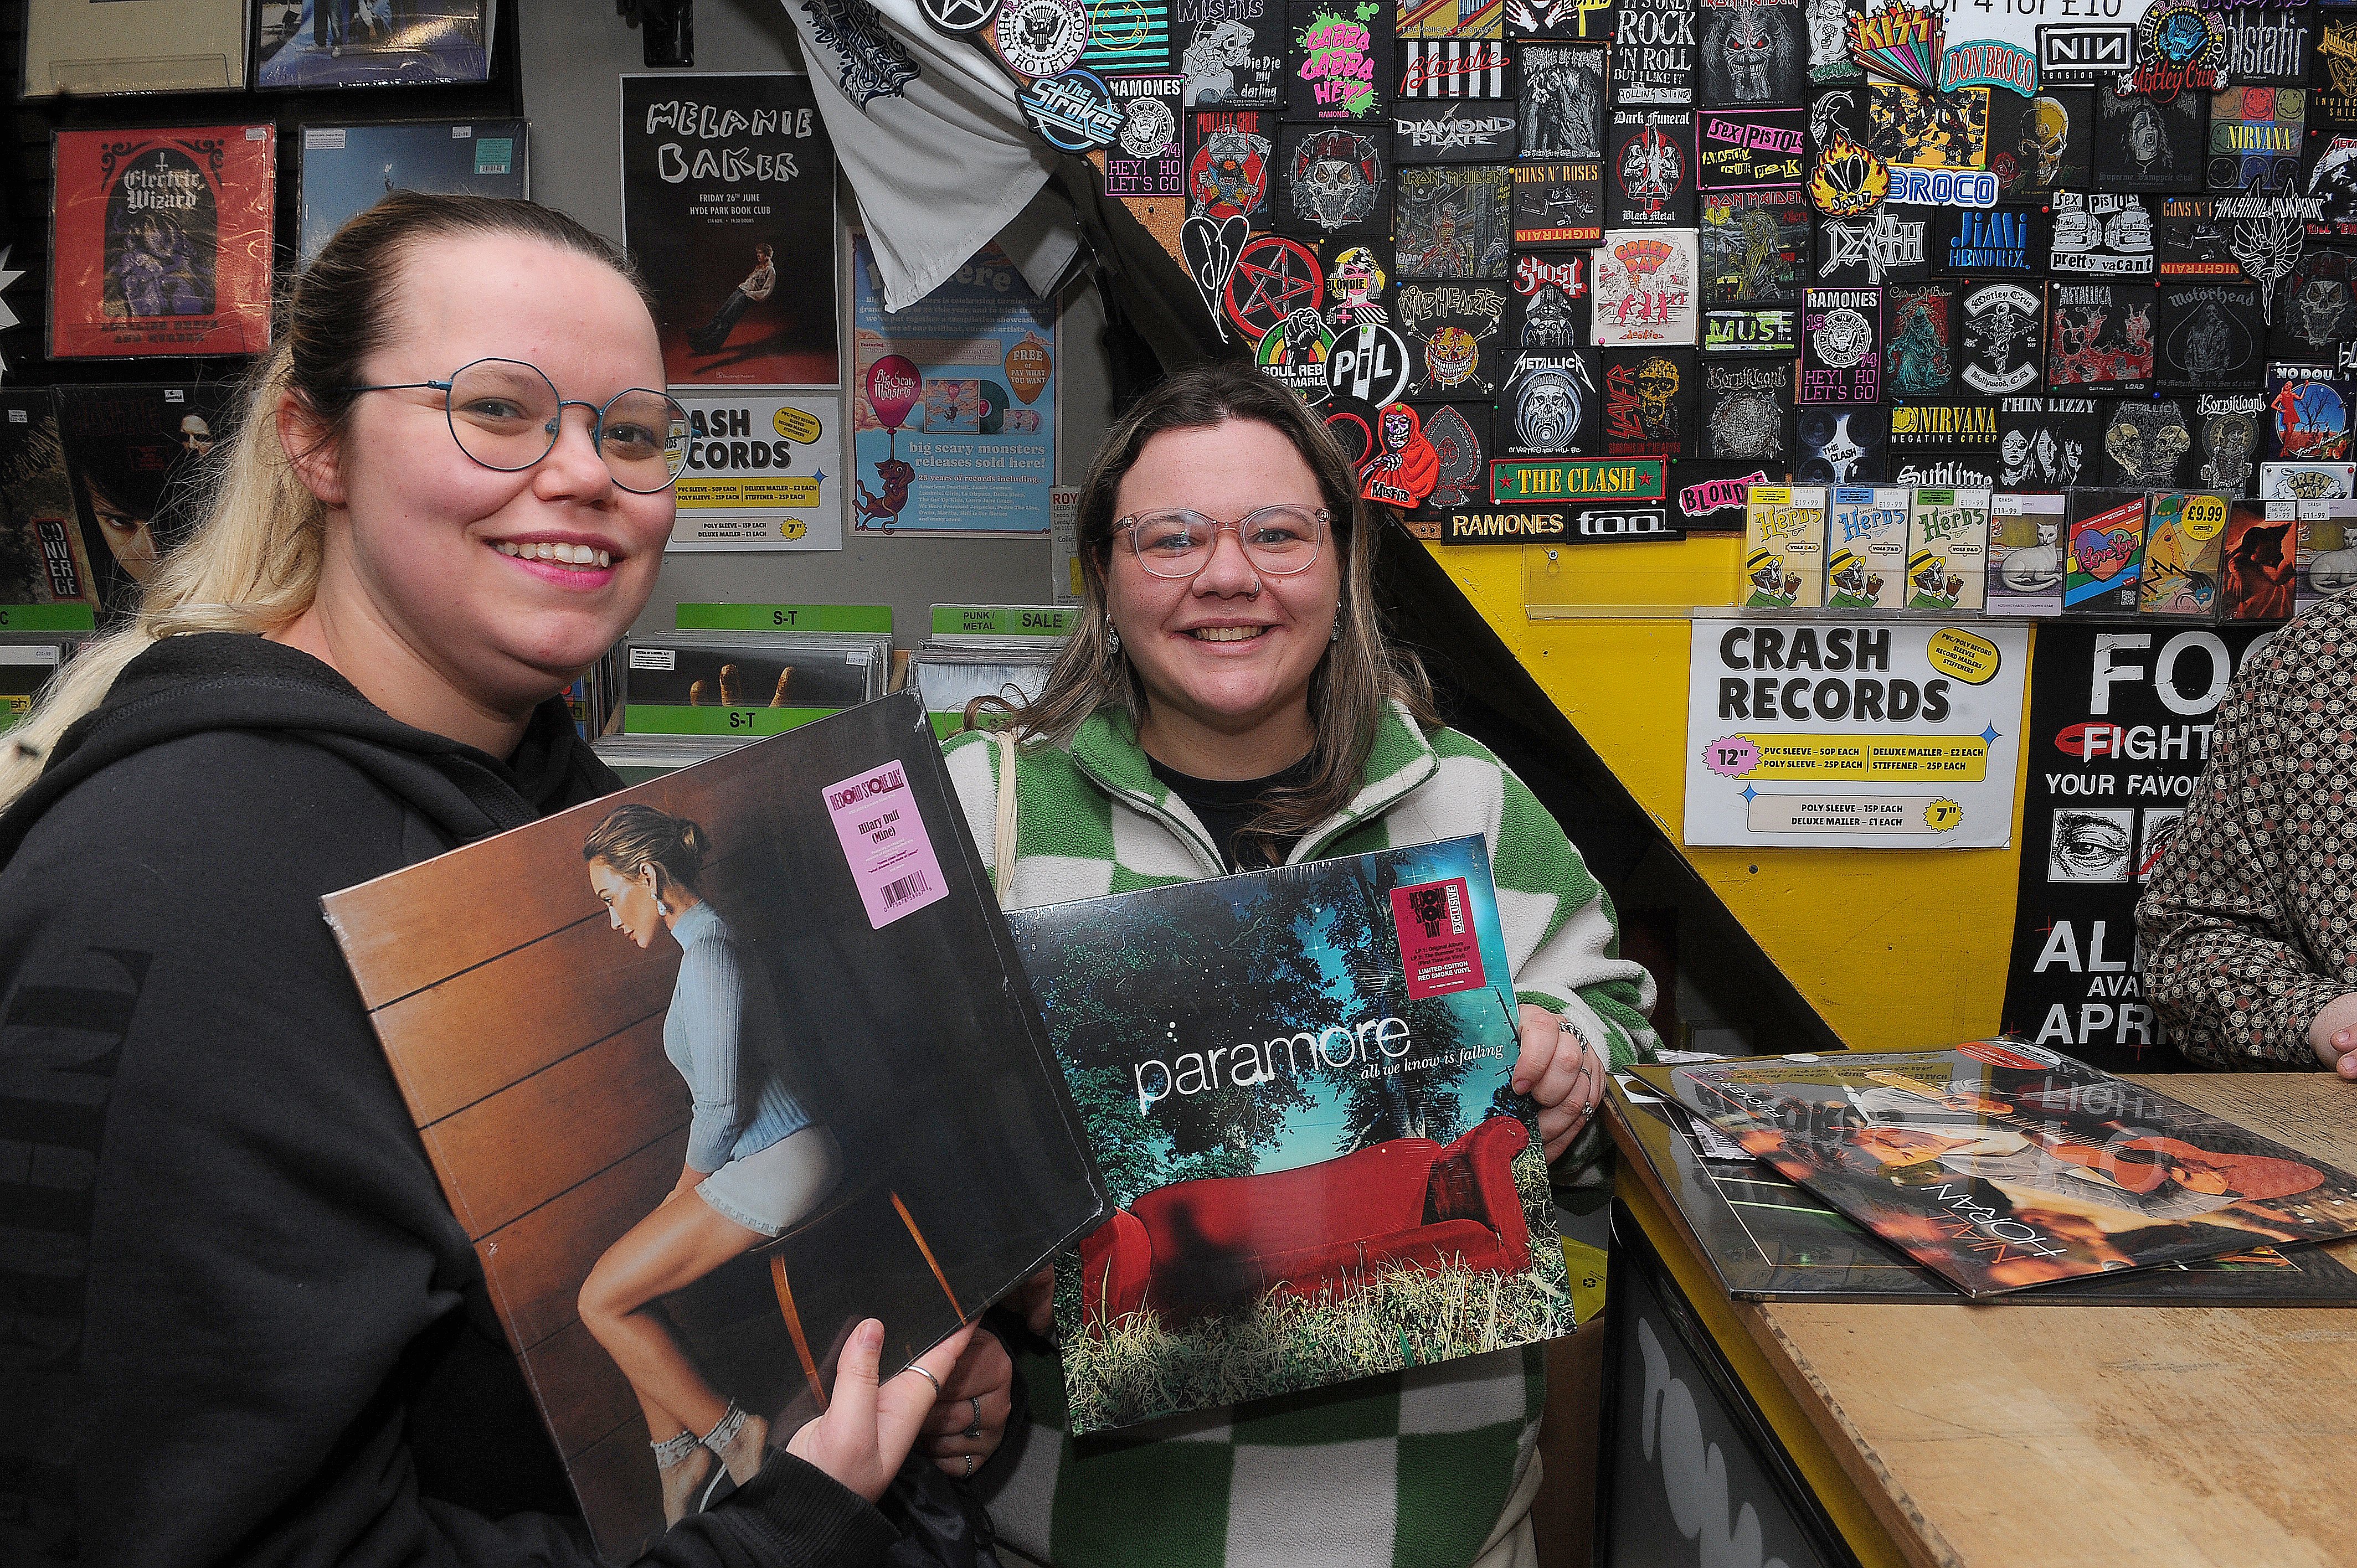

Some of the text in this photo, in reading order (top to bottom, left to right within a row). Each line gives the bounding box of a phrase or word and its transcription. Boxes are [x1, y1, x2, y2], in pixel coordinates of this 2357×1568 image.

[1617, 11, 1695, 44] ROCK
[1857, 8, 1929, 50] KISS
[999, 20, 1035, 72] HEY HO
[1643, 48, 1691, 70] ROLL
[1401, 45, 1510, 94] Blondie
[1614, 70, 1685, 85] BUT LIKE IT
[1949, 47, 2035, 92] DON BROCO
[1065, 78, 1091, 97] The
[1032, 79, 1124, 140] Strokes
[647, 101, 812, 138] MELANIE
[1394, 116, 1516, 136] DIAMOND
[1614, 111, 1690, 126] Dark Funeral
[1413, 134, 1497, 147] PLATE
[2227, 126, 2291, 150] NIRVANA
[1163, 143, 1180, 158] 74
[658, 143, 799, 183] BAKER
[1159, 161, 1180, 175] HO
[123, 168, 200, 191] Electric
[1403, 171, 1504, 187] IRON MAIDEN
[1515, 165, 1598, 183] GUNS ROSES
[1823, 154, 1864, 197] NO
[1109, 177, 1179, 191] LET'S GO
[1890, 171, 1993, 204] BROCO
[127, 189, 197, 214] Wizard
[1704, 191, 1806, 210] IRON MAIDEN
[2163, 200, 2191, 216] GUNS
[690, 207, 771, 215] HYDE PARK BOOK CLUB
[1622, 211, 1675, 221] Black Metal
[1517, 229, 1599, 241] NIGHTRAIN
[2307, 223, 2331, 235] KILL
[1614, 240, 1674, 260] GREEN
[1820, 207, 1926, 285] DEATH
[1627, 257, 1664, 274] DAY
[2053, 254, 2096, 272] pretty
[2162, 263, 2239, 275] NIGHTRAIN
[1327, 278, 1365, 291] BLONDIE
[1808, 292, 1879, 307] RAMONES
[2060, 286, 2112, 307] METALLICA
[2168, 287, 2254, 307] Motörhead
[1705, 316, 1794, 343] MUSE
[1807, 314, 1825, 331] 19
[1013, 349, 1043, 362] FREE
[1262, 365, 1296, 377] SOUL
[1502, 350, 1596, 394] METALLICA
[1855, 370, 1875, 384] HO
[2277, 368, 2298, 379] NO
[1607, 363, 1649, 440] SLAYER
[1804, 386, 1875, 400] LET'S GO
[2001, 398, 2098, 414] THIN LIZZY
[1918, 407, 1998, 435] NIRVANA
[1891, 435, 1998, 443] NEGATIVE CREEP
[909, 442, 1046, 455] big scary monsters
[1823, 445, 1839, 455] THE
[1830, 448, 1857, 462] CLASH
[915, 457, 1046, 468] releases sold here!
[1518, 467, 1636, 493] THE CLASH
[2287, 472, 2332, 488] GREEN
[2127, 502, 2142, 513] 2025
[2188, 506, 2223, 522] £9.99
[1453, 513, 1564, 537] RAMONES
[773, 611, 797, 625] S-T
[963, 611, 990, 620] PUNK
[1022, 613, 1063, 628] SALE
[963, 622, 995, 630] METAL
[1720, 627, 1891, 672] CRASH
[1718, 678, 1952, 722] RECORDS
[730, 713, 755, 729] S-T
[2047, 774, 2114, 795] YOUR
[858, 817, 882, 835] Hilary
[1447, 886, 1464, 933] EXCLUSIVE
[1425, 921, 1440, 937] DAY
[1418, 961, 1468, 974] LIMITED-EDITION
[1454, 967, 1471, 976] VINYL
[1135, 1018, 1410, 1116] paramore
[1361, 1043, 1504, 1079] all we know is falling
[1920, 1184, 2068, 1256] HORAN
